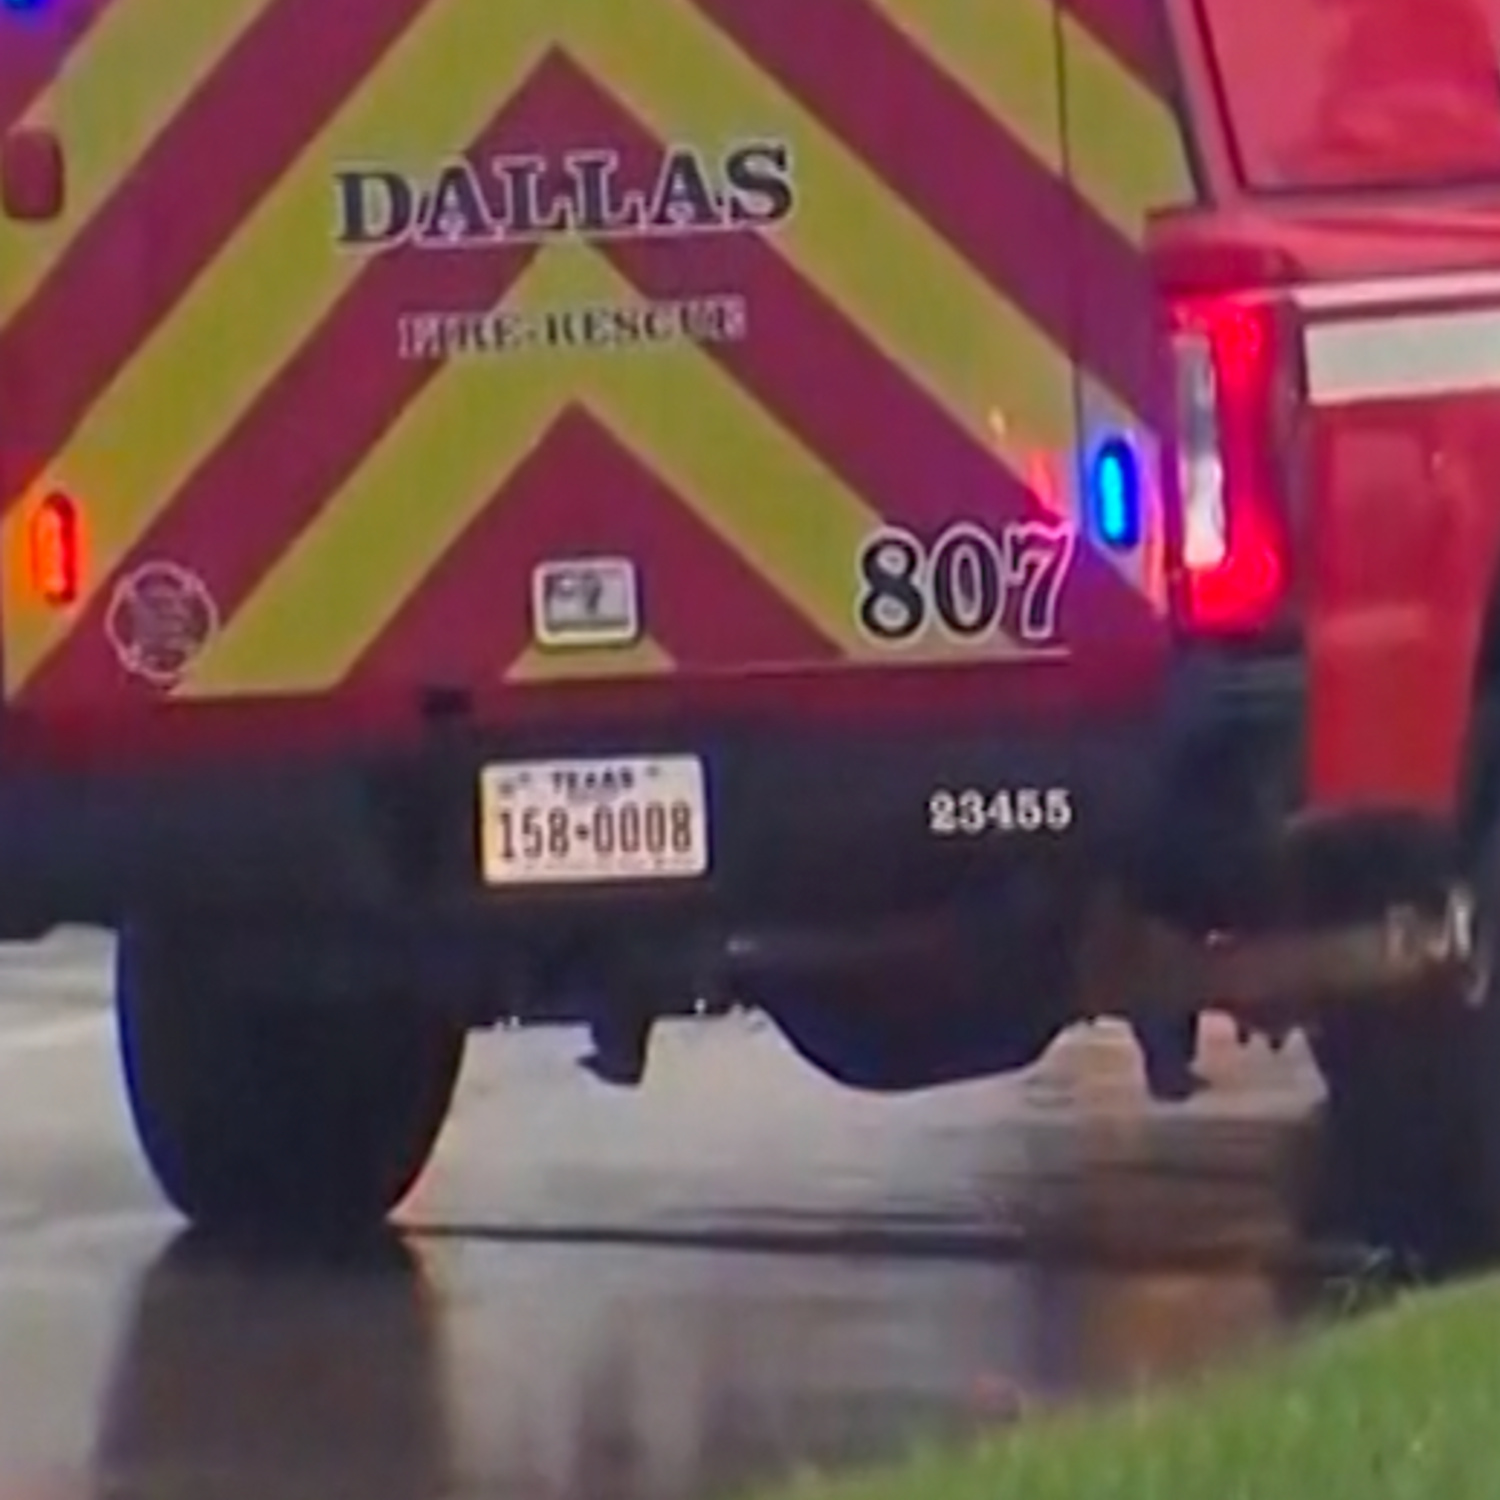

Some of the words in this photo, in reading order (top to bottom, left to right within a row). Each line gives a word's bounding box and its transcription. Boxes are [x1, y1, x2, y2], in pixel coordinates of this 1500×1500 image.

[333, 135, 796, 250] DALLAS
[855, 519, 1075, 647] 807
[551, 766, 636, 793] TEXAS
[929, 787, 1073, 836] 23455
